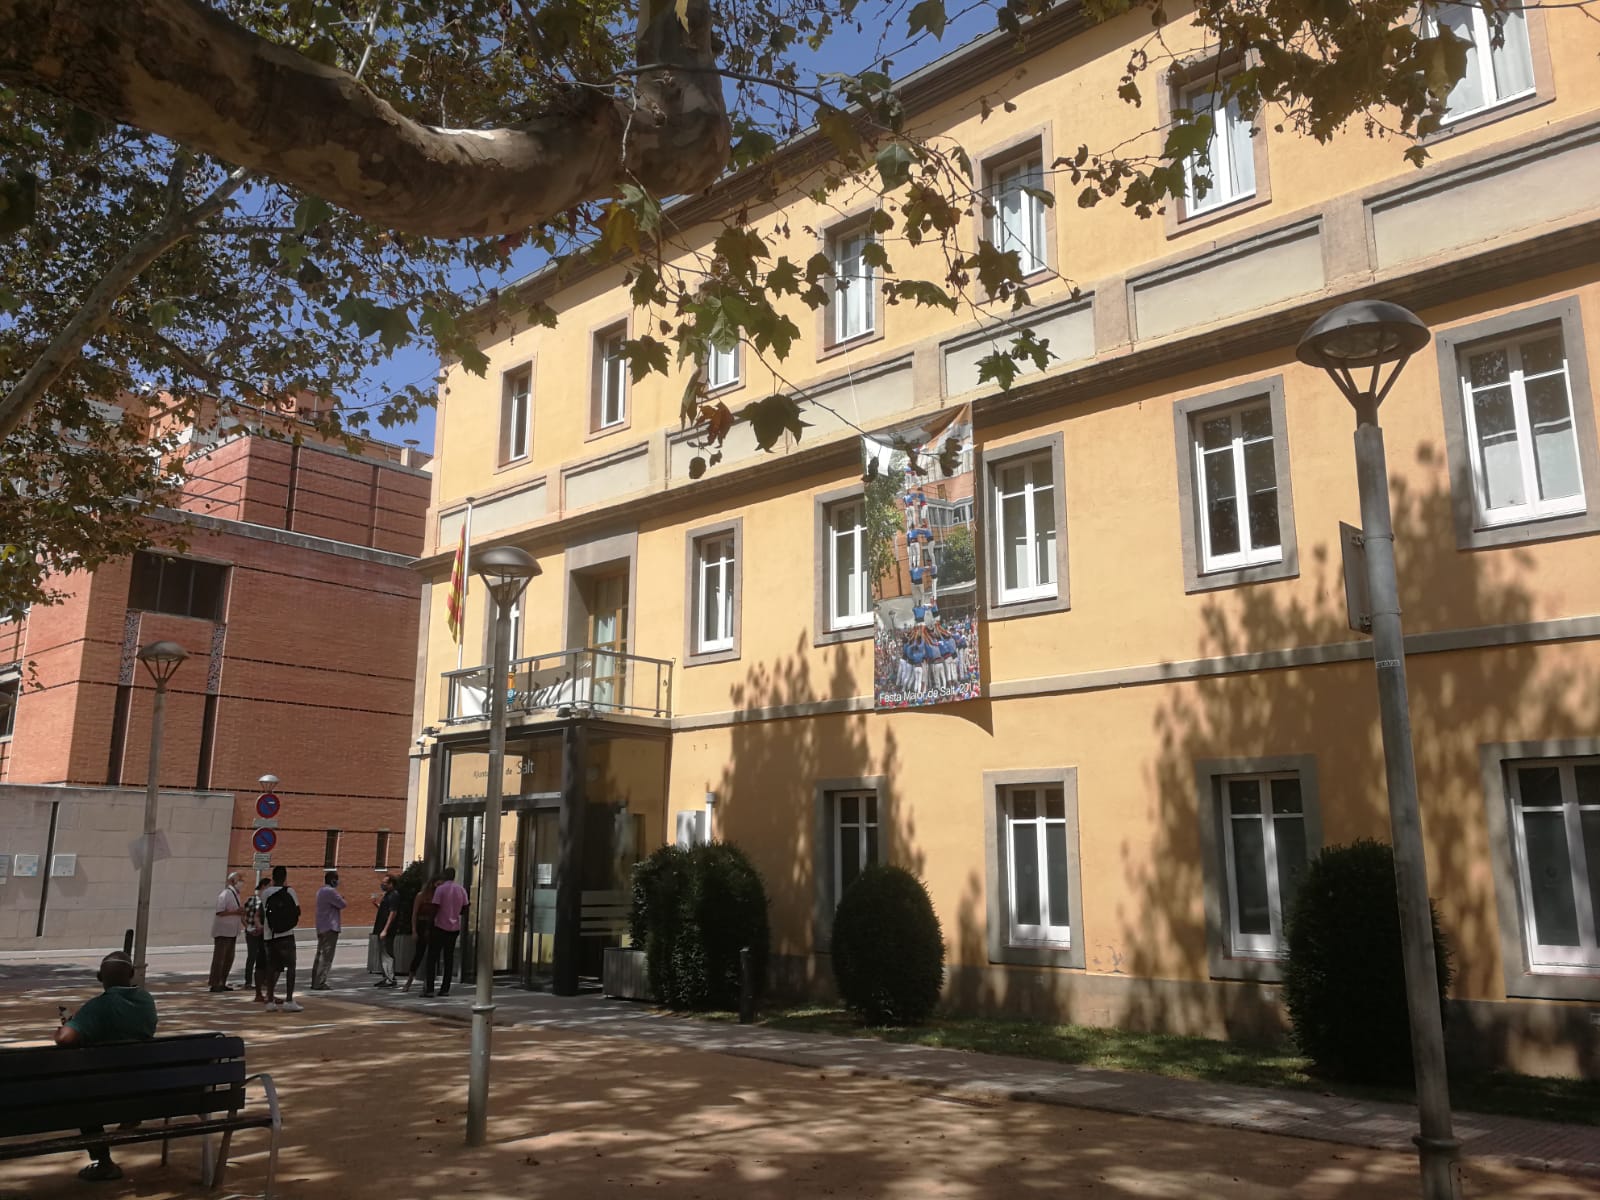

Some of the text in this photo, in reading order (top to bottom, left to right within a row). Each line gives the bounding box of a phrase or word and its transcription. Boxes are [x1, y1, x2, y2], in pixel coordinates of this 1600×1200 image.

[879, 692, 902, 703] Festa
[927, 687, 938, 698] de
[505, 767, 512, 776] de
[516, 759, 534, 775] Salt
